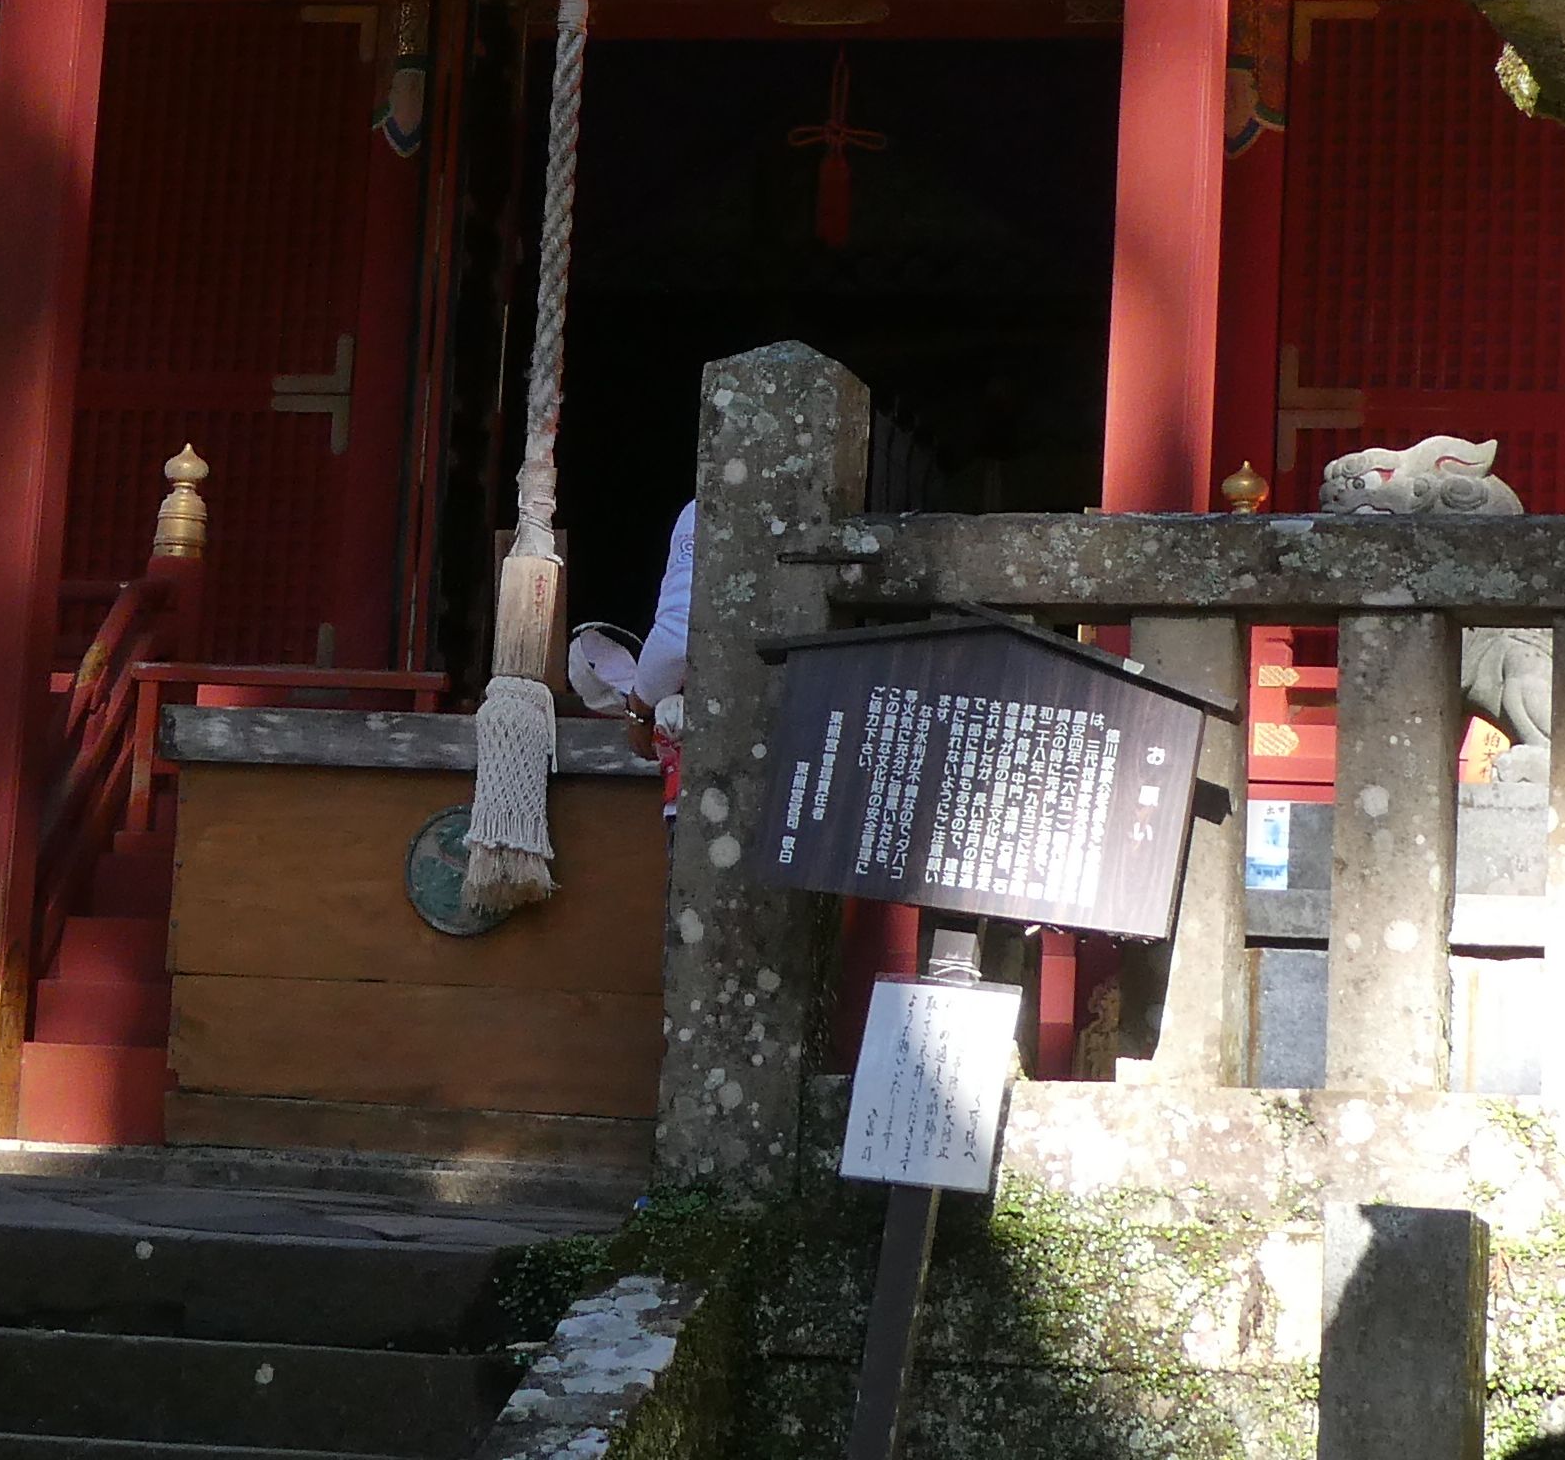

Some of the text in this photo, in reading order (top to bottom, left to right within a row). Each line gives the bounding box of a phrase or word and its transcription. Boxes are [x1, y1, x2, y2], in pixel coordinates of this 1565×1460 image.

[812, 710, 844, 821] 東照宮管理責任者
[855, 686, 901, 875] この貴重な文化財の安全管理に
[925, 695, 970, 884] 物に触れないようにご注意願い
[1131, 745, 1166, 843] お願い
